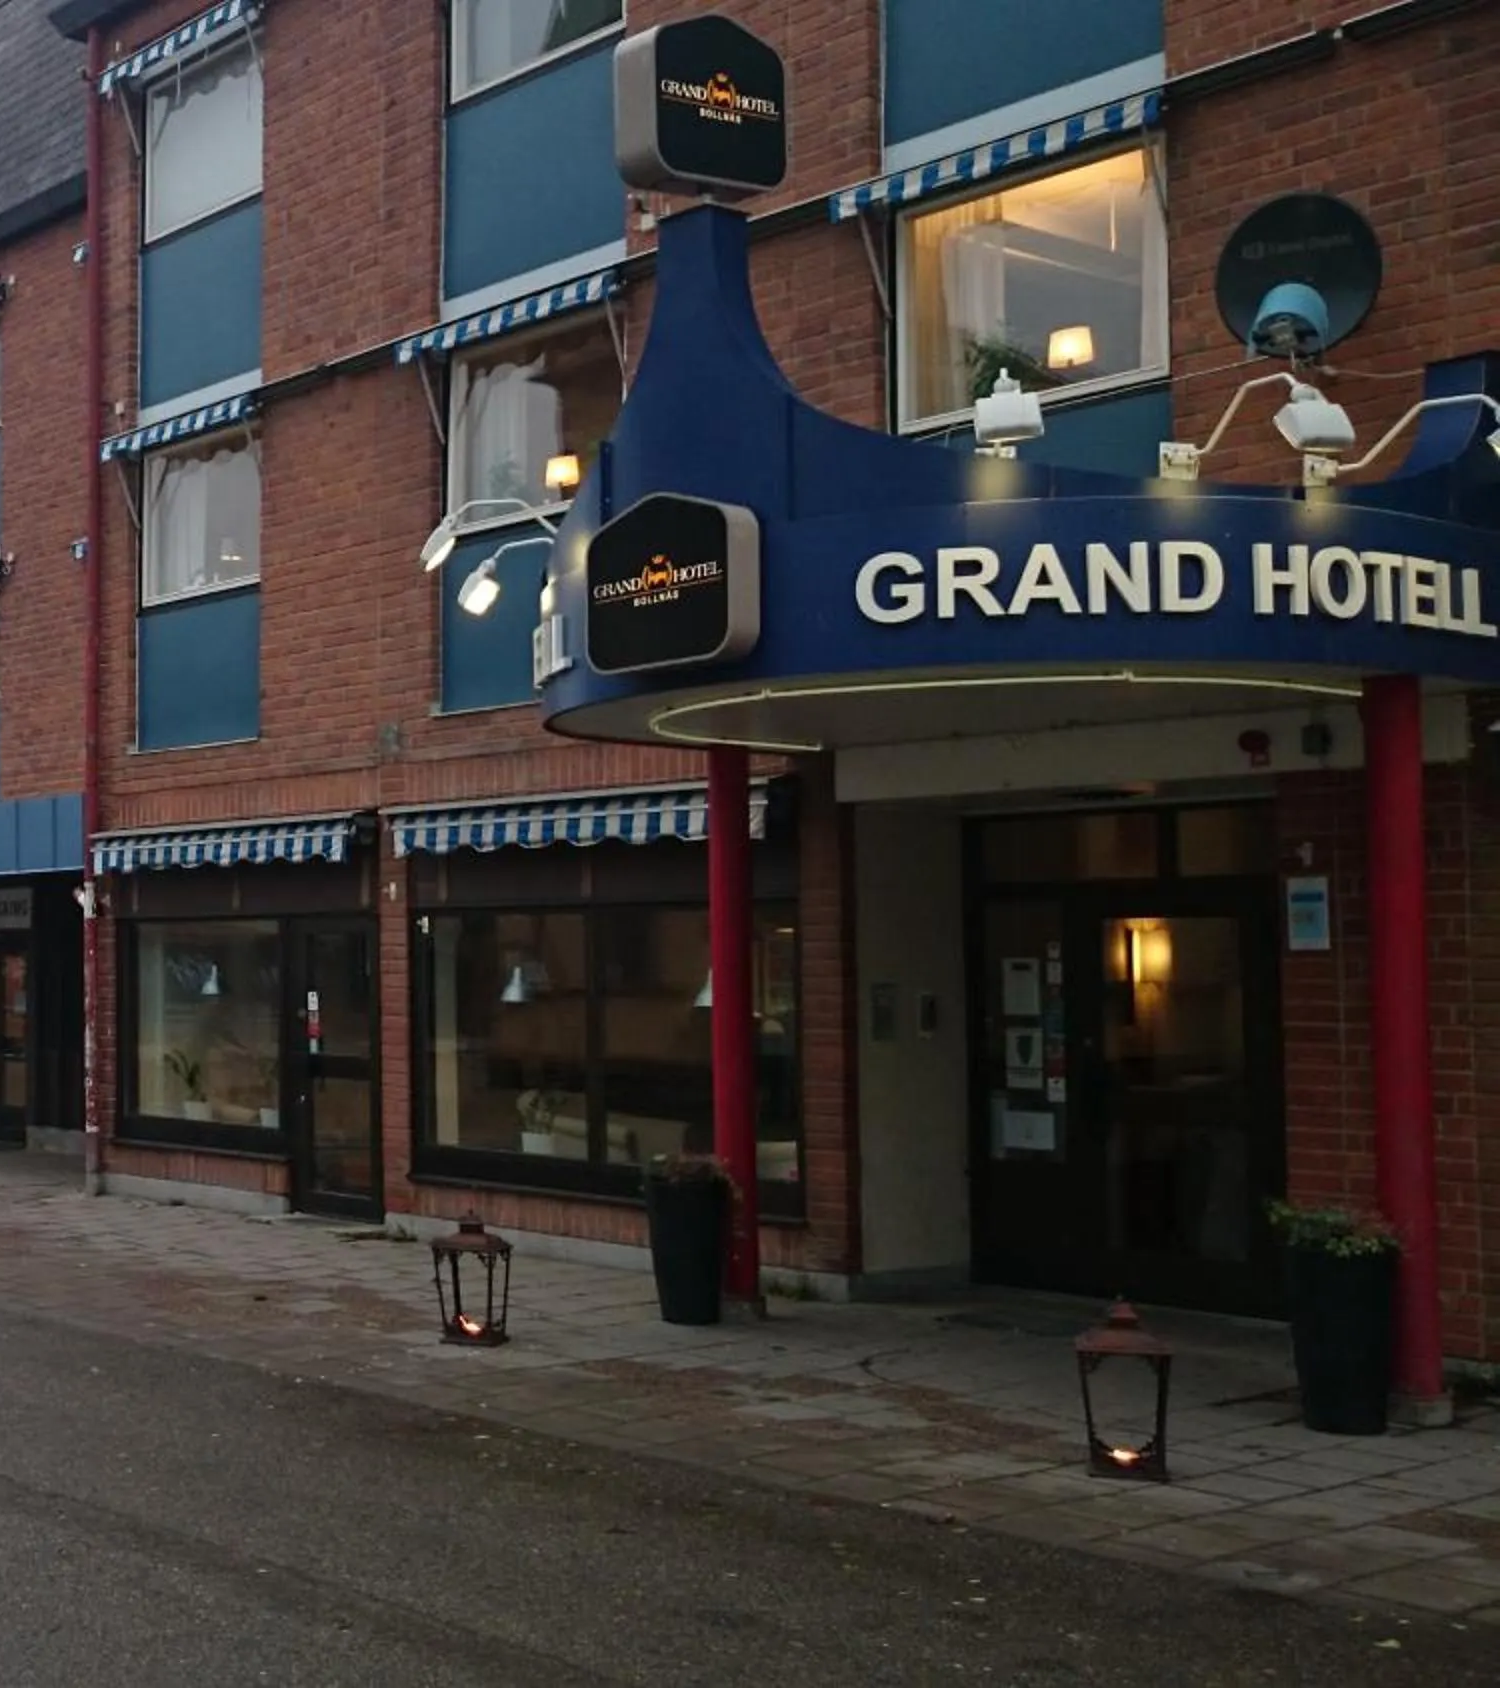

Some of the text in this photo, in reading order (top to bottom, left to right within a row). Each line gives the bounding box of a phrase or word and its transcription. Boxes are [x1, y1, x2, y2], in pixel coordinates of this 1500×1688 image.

[660, 79, 779, 116] GRAND HOTEL
[593, 560, 724, 599] GRAND HOTEL
[855, 541, 1498, 638] GRAND HOTELL
